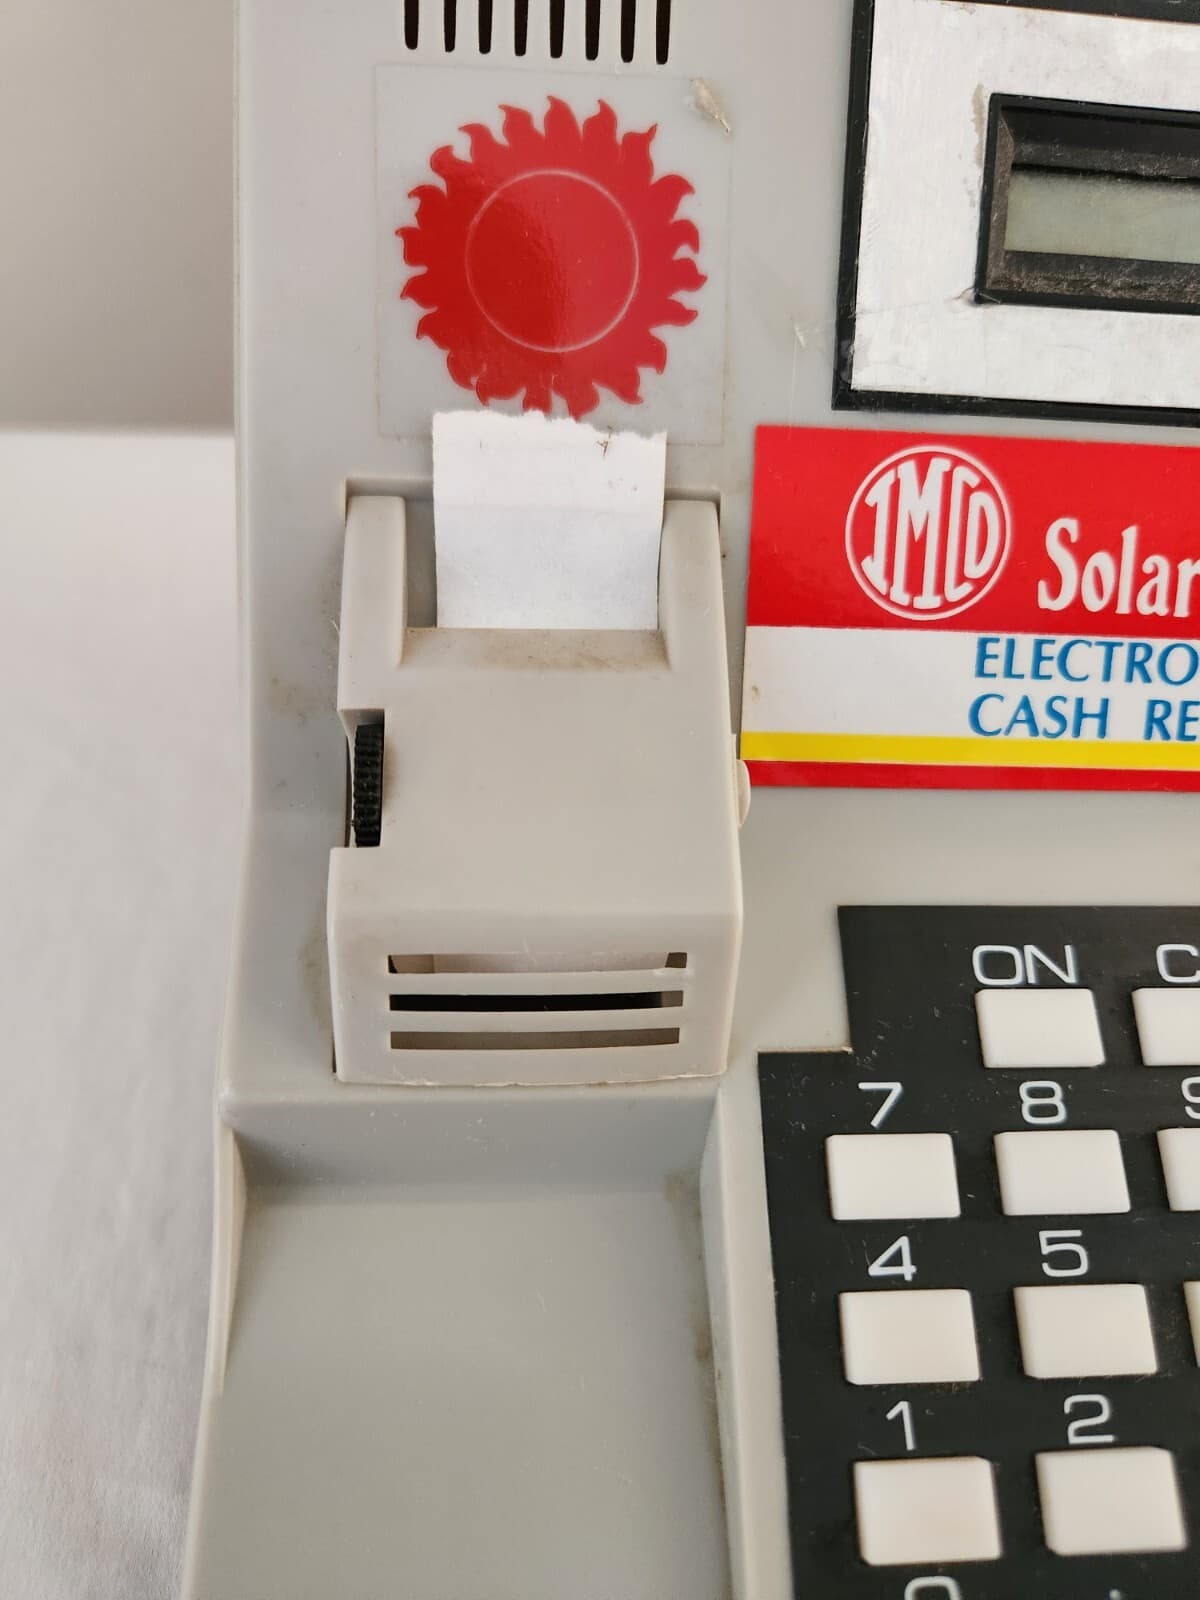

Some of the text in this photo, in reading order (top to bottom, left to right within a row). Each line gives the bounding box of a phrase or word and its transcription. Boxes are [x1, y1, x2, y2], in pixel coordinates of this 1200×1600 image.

[1038, 517, 1200, 618] Solar
[975, 635, 1200, 687] ELECTRO
[967, 692, 1200, 742] CASH RE
[972, 944, 1077, 985] ON
[858, 1081, 903, 1128] 7
[1019, 1080, 1067, 1125] 8
[868, 1235, 917, 1282] 4
[1038, 1229, 1089, 1277] 5
[886, 1400, 915, 1451] 1
[1063, 1394, 1115, 1445] 2
